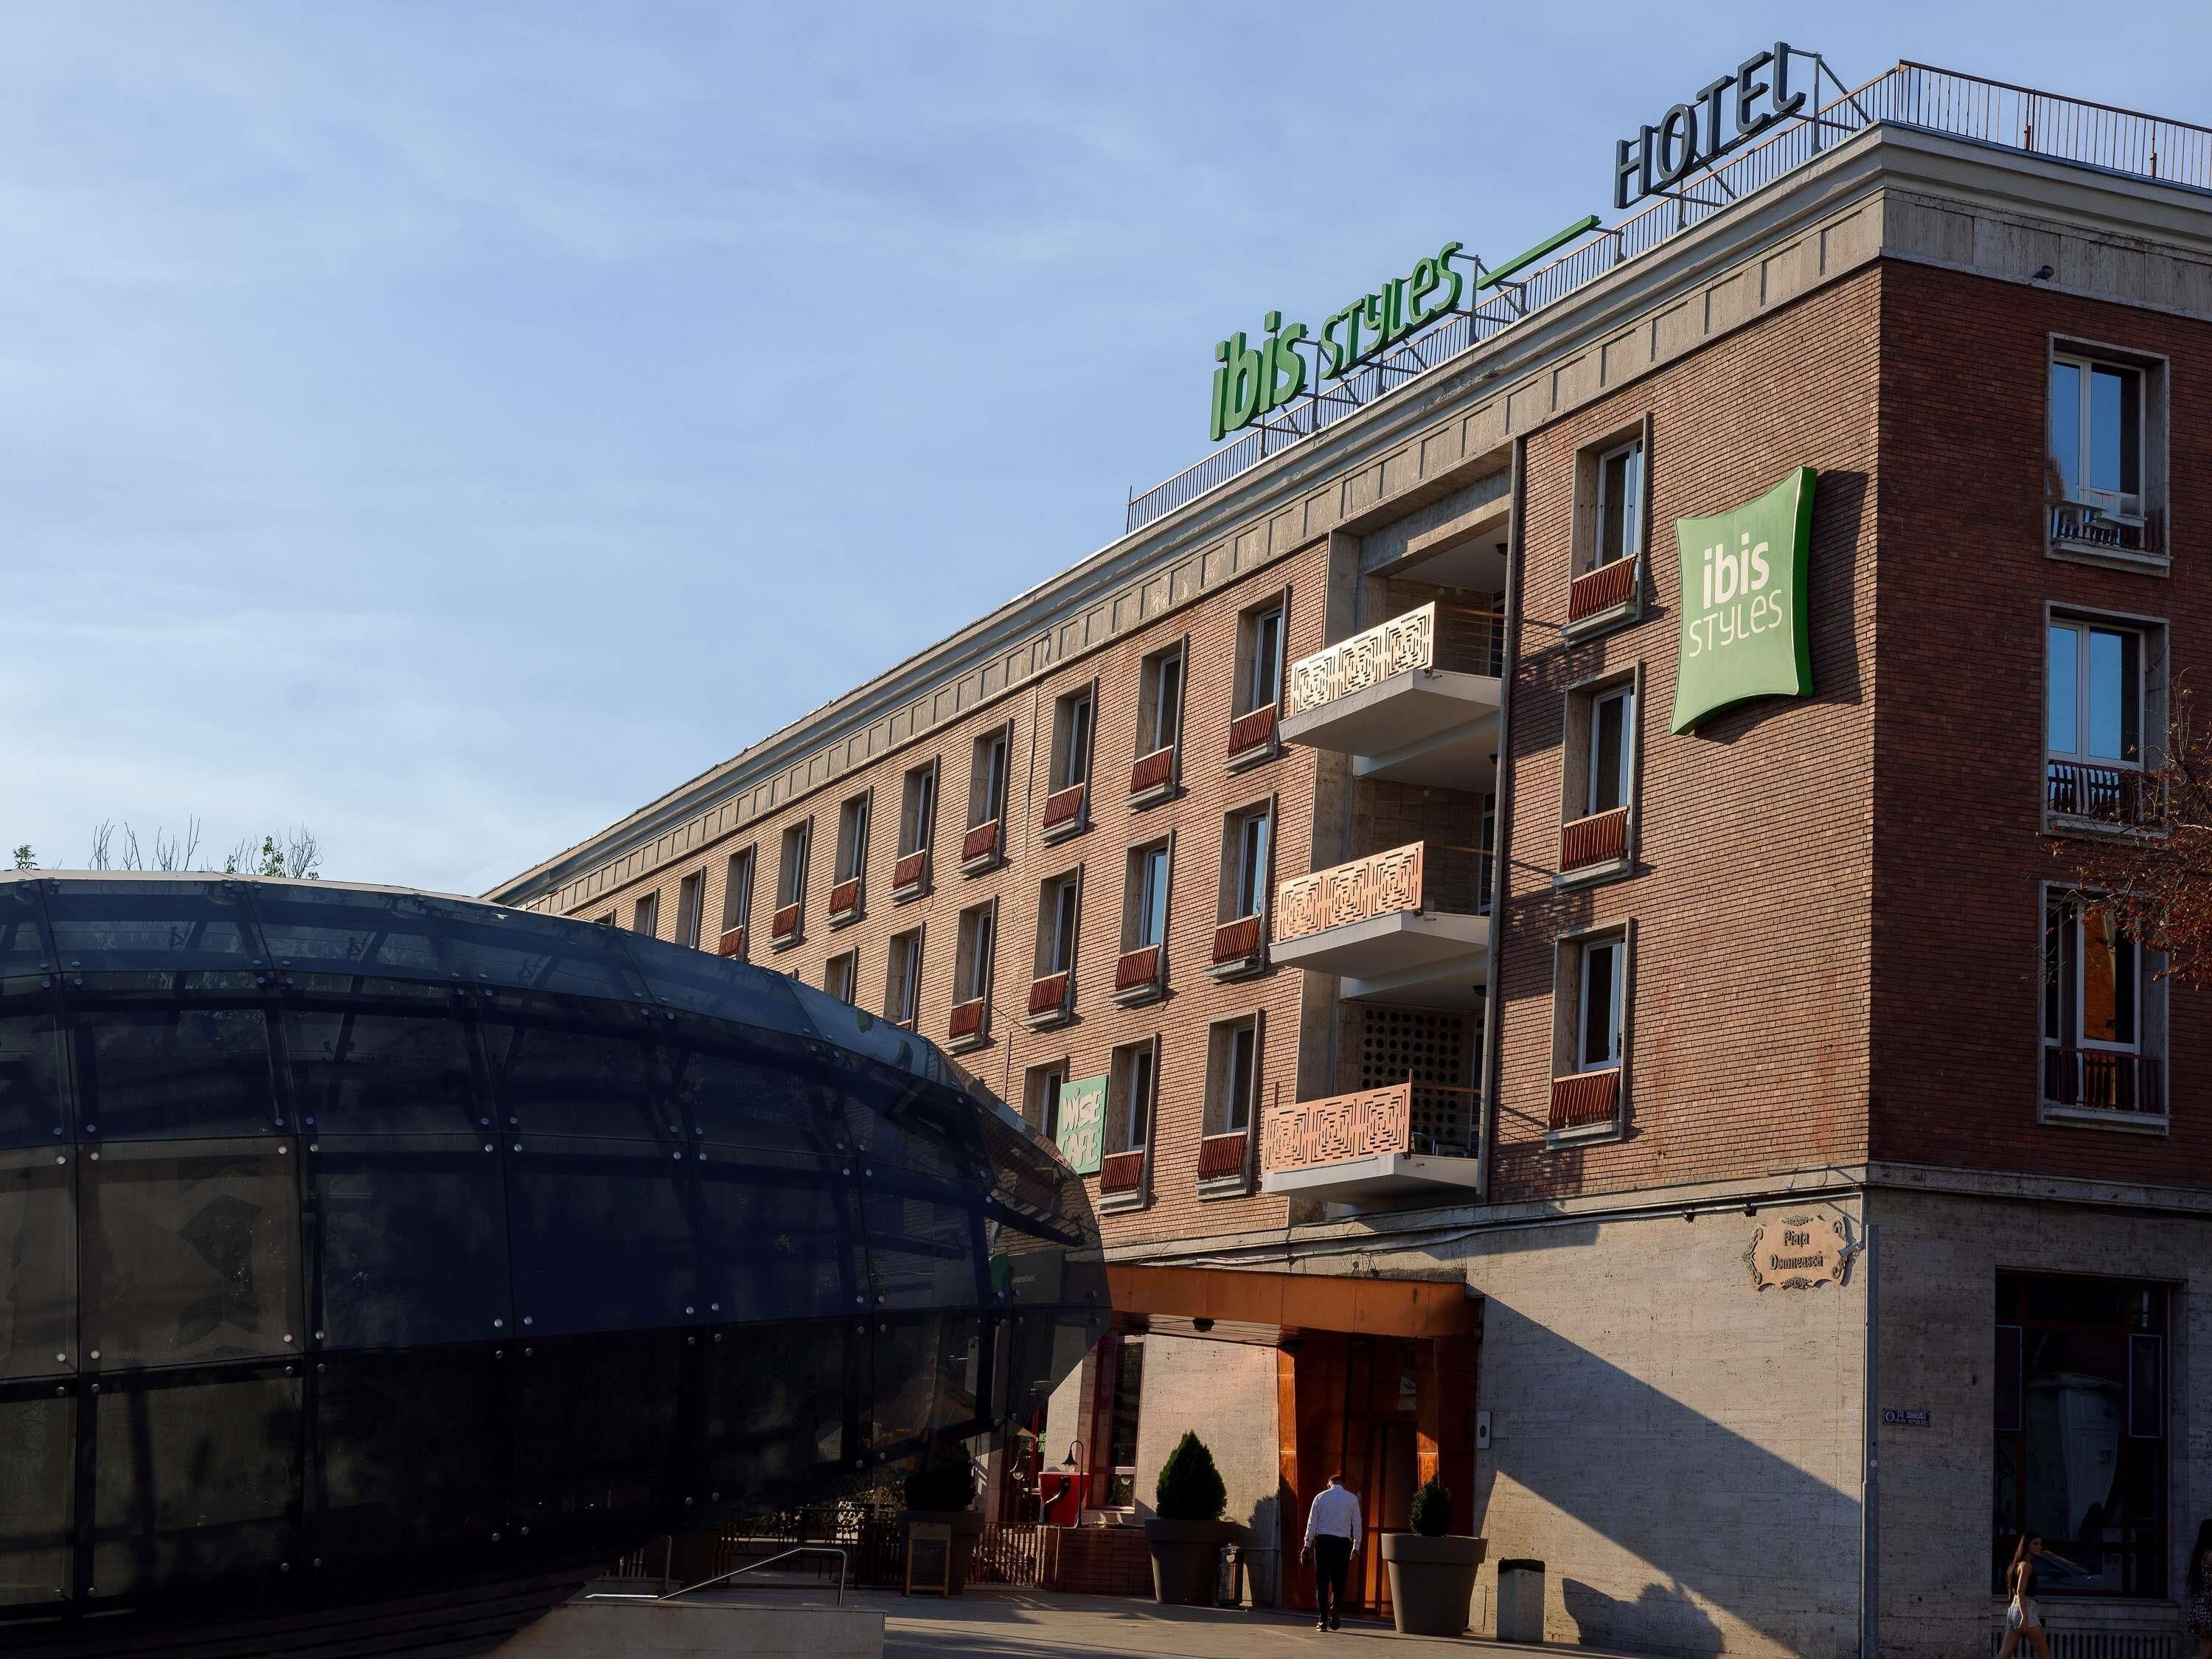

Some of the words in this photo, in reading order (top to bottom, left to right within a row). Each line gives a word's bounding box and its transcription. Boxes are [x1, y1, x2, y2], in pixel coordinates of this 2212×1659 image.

[1614, 41, 1806, 209] HOTEL
[1210, 310, 1307, 442] ibis
[1703, 532, 1770, 610] ibis
